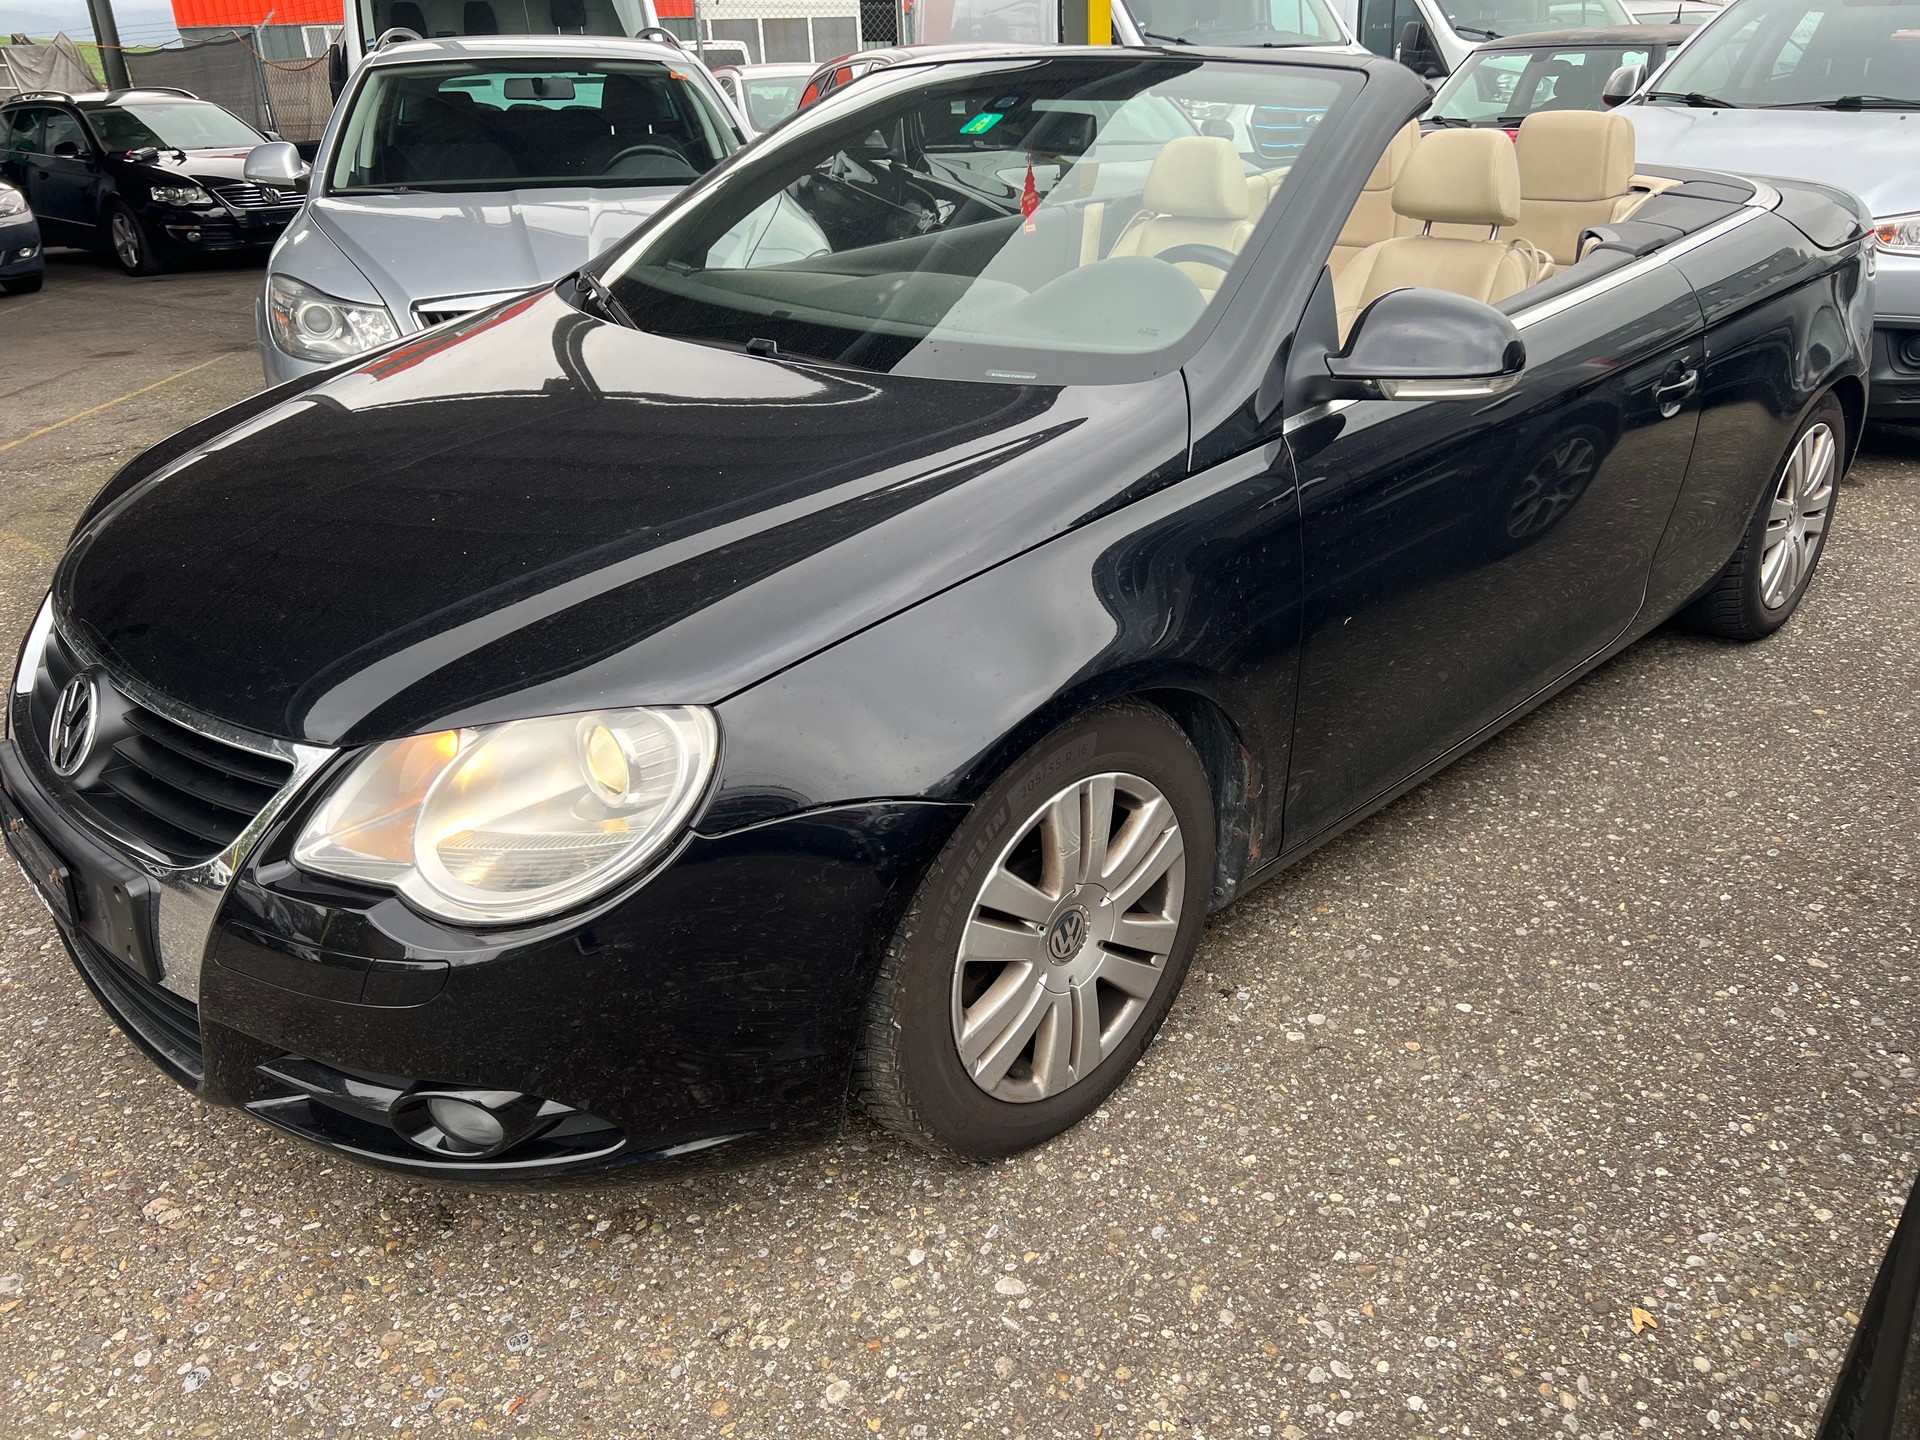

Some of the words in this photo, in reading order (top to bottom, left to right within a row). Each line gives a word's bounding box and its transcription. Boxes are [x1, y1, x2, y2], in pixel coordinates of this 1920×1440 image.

[1021, 757, 1062, 799] 205/55
[1065, 751, 1073, 764] R
[1078, 744, 1088, 757] 16
[934, 806, 1007, 943] MICHELIN
[1050, 910, 1085, 959] VW
